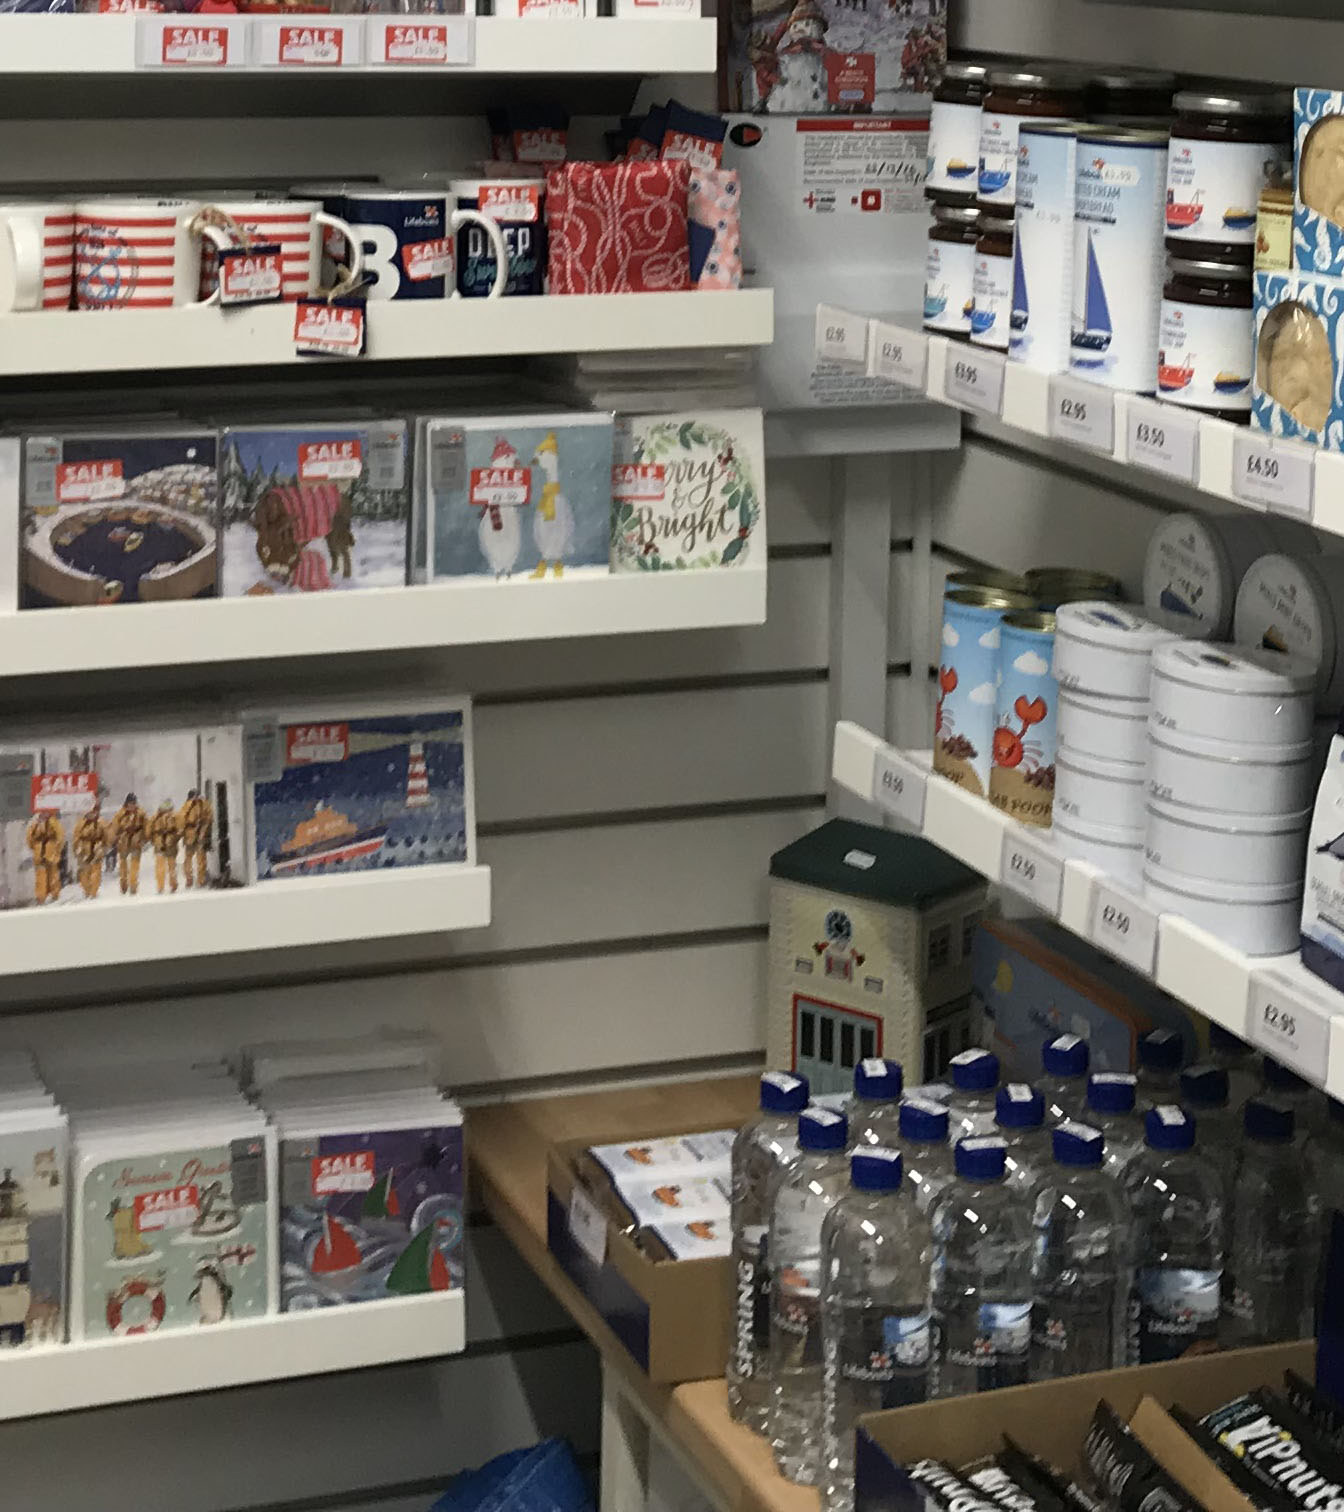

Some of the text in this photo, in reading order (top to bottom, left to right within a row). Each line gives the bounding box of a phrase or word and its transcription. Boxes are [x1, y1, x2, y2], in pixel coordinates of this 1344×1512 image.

[172, 29, 219, 45] SALE
[288, 30, 335, 47] SALE
[394, 27, 439, 45] SALE
[670, 136, 715, 159] SALE
[486, 188, 530, 202] SALE
[410, 241, 452, 261] SALE
[231, 259, 275, 276] SALE
[305, 307, 352, 324] SALE
[305, 445, 353, 460] SALE
[65, 465, 112, 482] SALE
[1248, 457, 1278, 477] £4.50
[479, 471, 524, 485] SALE
[662, 456, 726, 503] erry
[637, 501, 737, 552] Bright
[295, 726, 341, 747] SALE
[40, 776, 90, 793] SALE
[1263, 1003, 1296, 1038] £2.95
[320, 1157, 367, 1173] SALE
[143, 1192, 192, 1210] SALE
